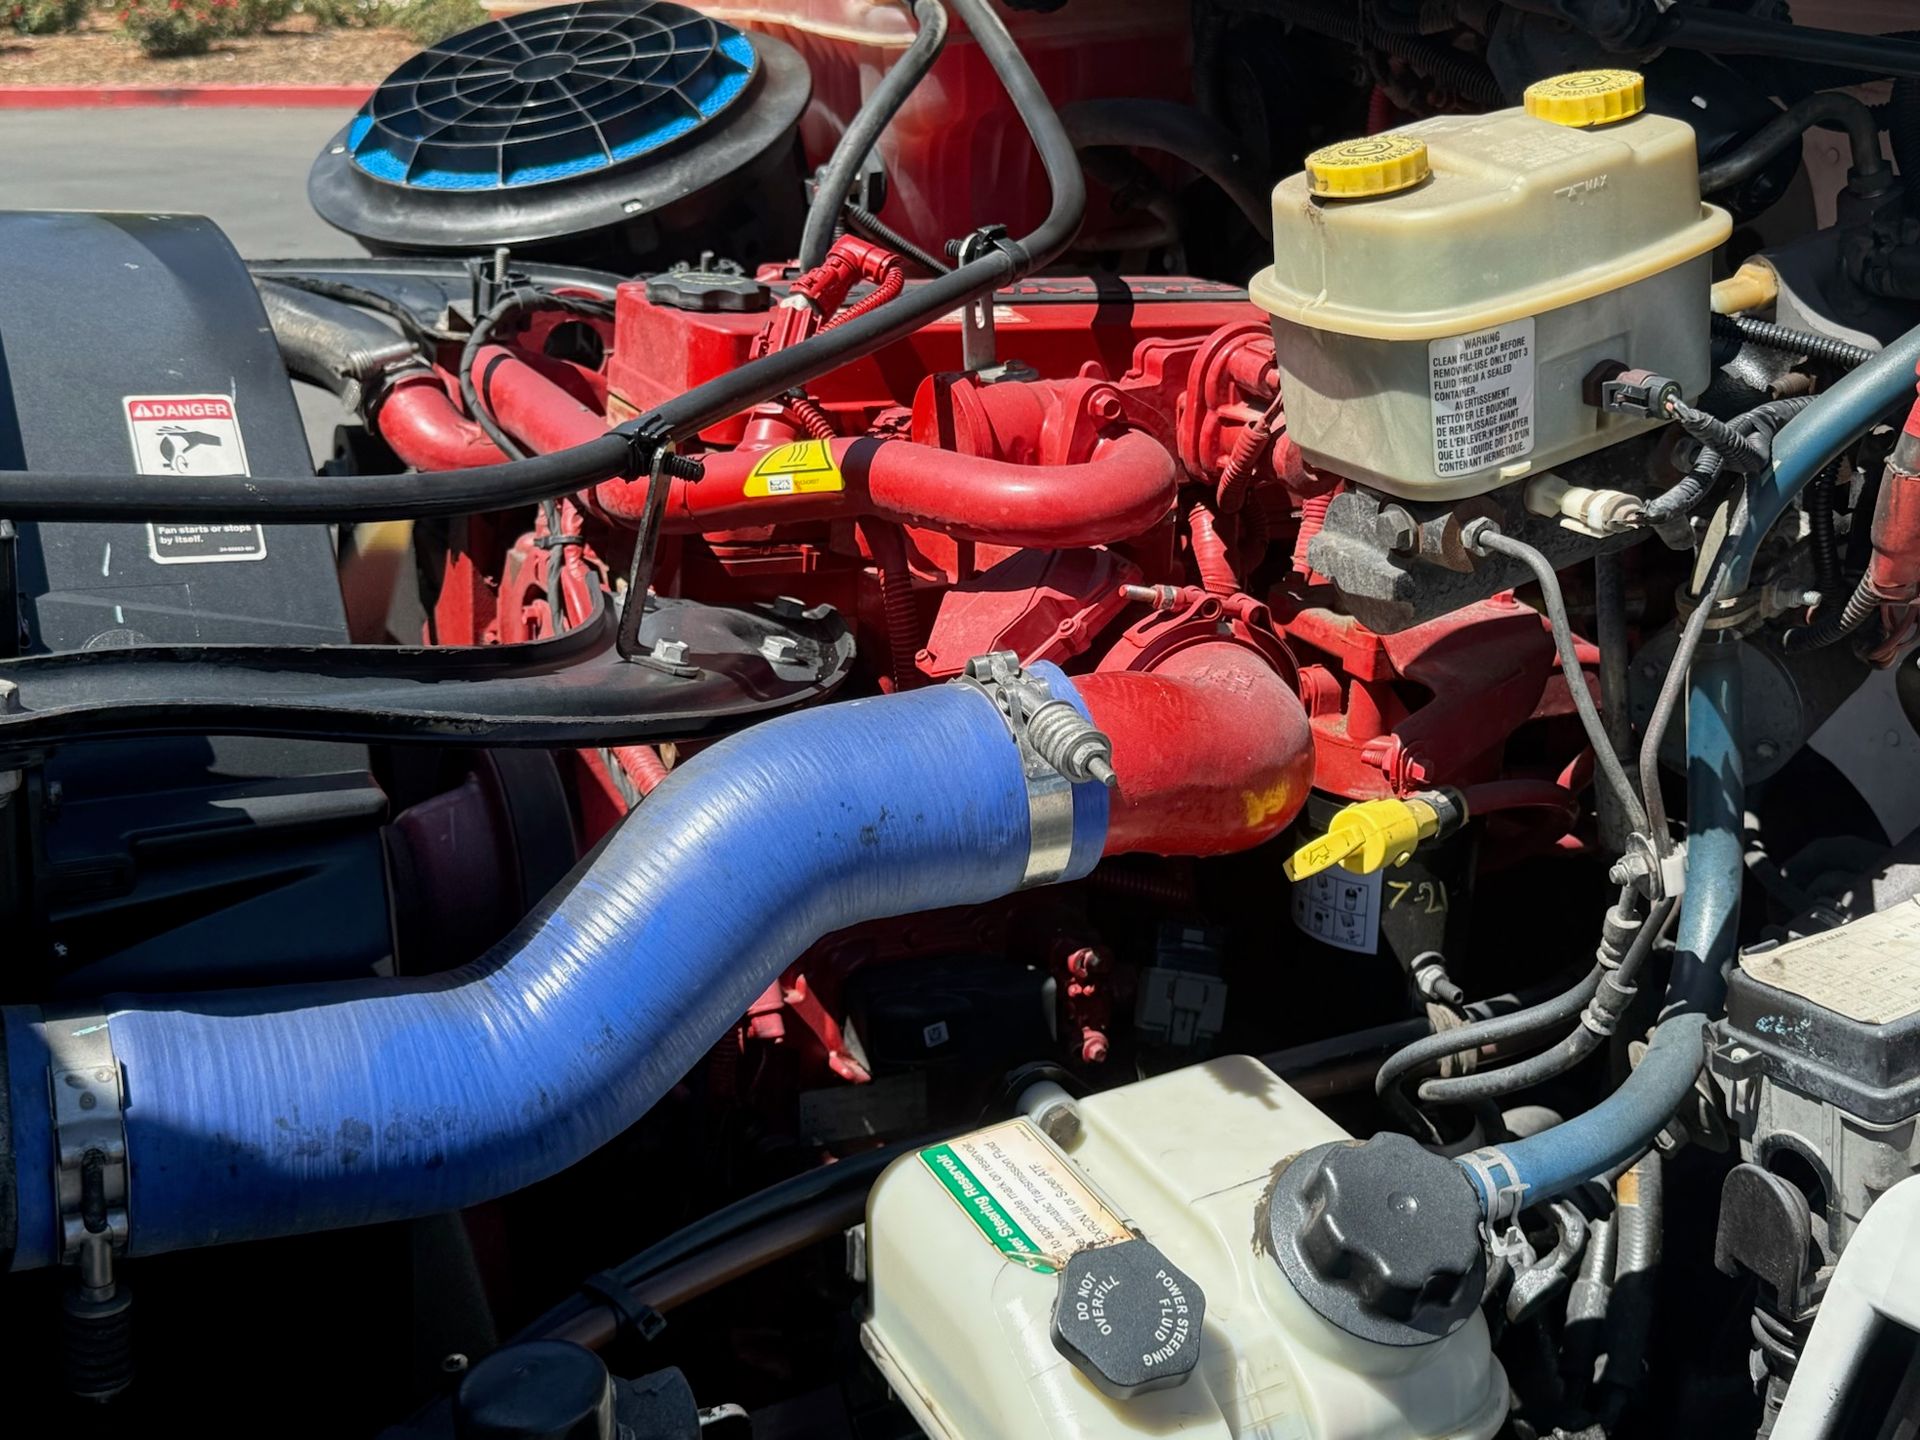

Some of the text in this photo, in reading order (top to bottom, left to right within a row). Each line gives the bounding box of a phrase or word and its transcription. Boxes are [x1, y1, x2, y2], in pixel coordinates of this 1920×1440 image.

[1433, 336, 1526, 367] CLEAN FILLER CAP BEFORE
[1464, 331, 1500, 350] WARNING
[1490, 355, 1507, 367] ONLY
[1509, 350, 1522, 361] DOT
[1523, 347, 1528, 357] 3
[1434, 364, 1512, 390] FLUID FROM A SEALED
[152, 404, 229, 418] DANGER
[1436, 397, 1517, 425] NETTOYER LE BOUCHON
[1455, 387, 1510, 411] AVERTISSEMENT
[1437, 408, 1519, 437] DE REMPLISSAGE AVANT
[1437, 439, 1447, 449] DE
[1438, 427, 1529, 460] QUE LE LIQUIDE DOT 3 D'UN
[1438, 456, 1482, 472] CONTENANT
[158, 524, 252, 534] Fan starts or stops
[159, 534, 205, 546] by itself.
[984, 1141, 1006, 1159] Fluid
[936, 1154, 980, 1198] Reservoir
[989, 1171, 1002, 1181] on
[1002, 1158, 1046, 1204] Transmission
[1044, 1177, 1068, 1198] Super
[998, 1180, 1018, 1199] mark
[1064, 1198, 1076, 1206] or
[974, 1195, 1014, 1237] Steering
[1014, 1200, 1055, 1240] appropriate
[1042, 1202, 1080, 1238] Automatic
[1051, 1240, 1063, 1249] to
[1076, 1271, 1097, 1321] DO NOT
[1092, 1275, 1121, 1336] OVERFILL
[1142, 1269, 1190, 1367] POWER STEERING
[1154, 1298, 1174, 1342] FLUID
